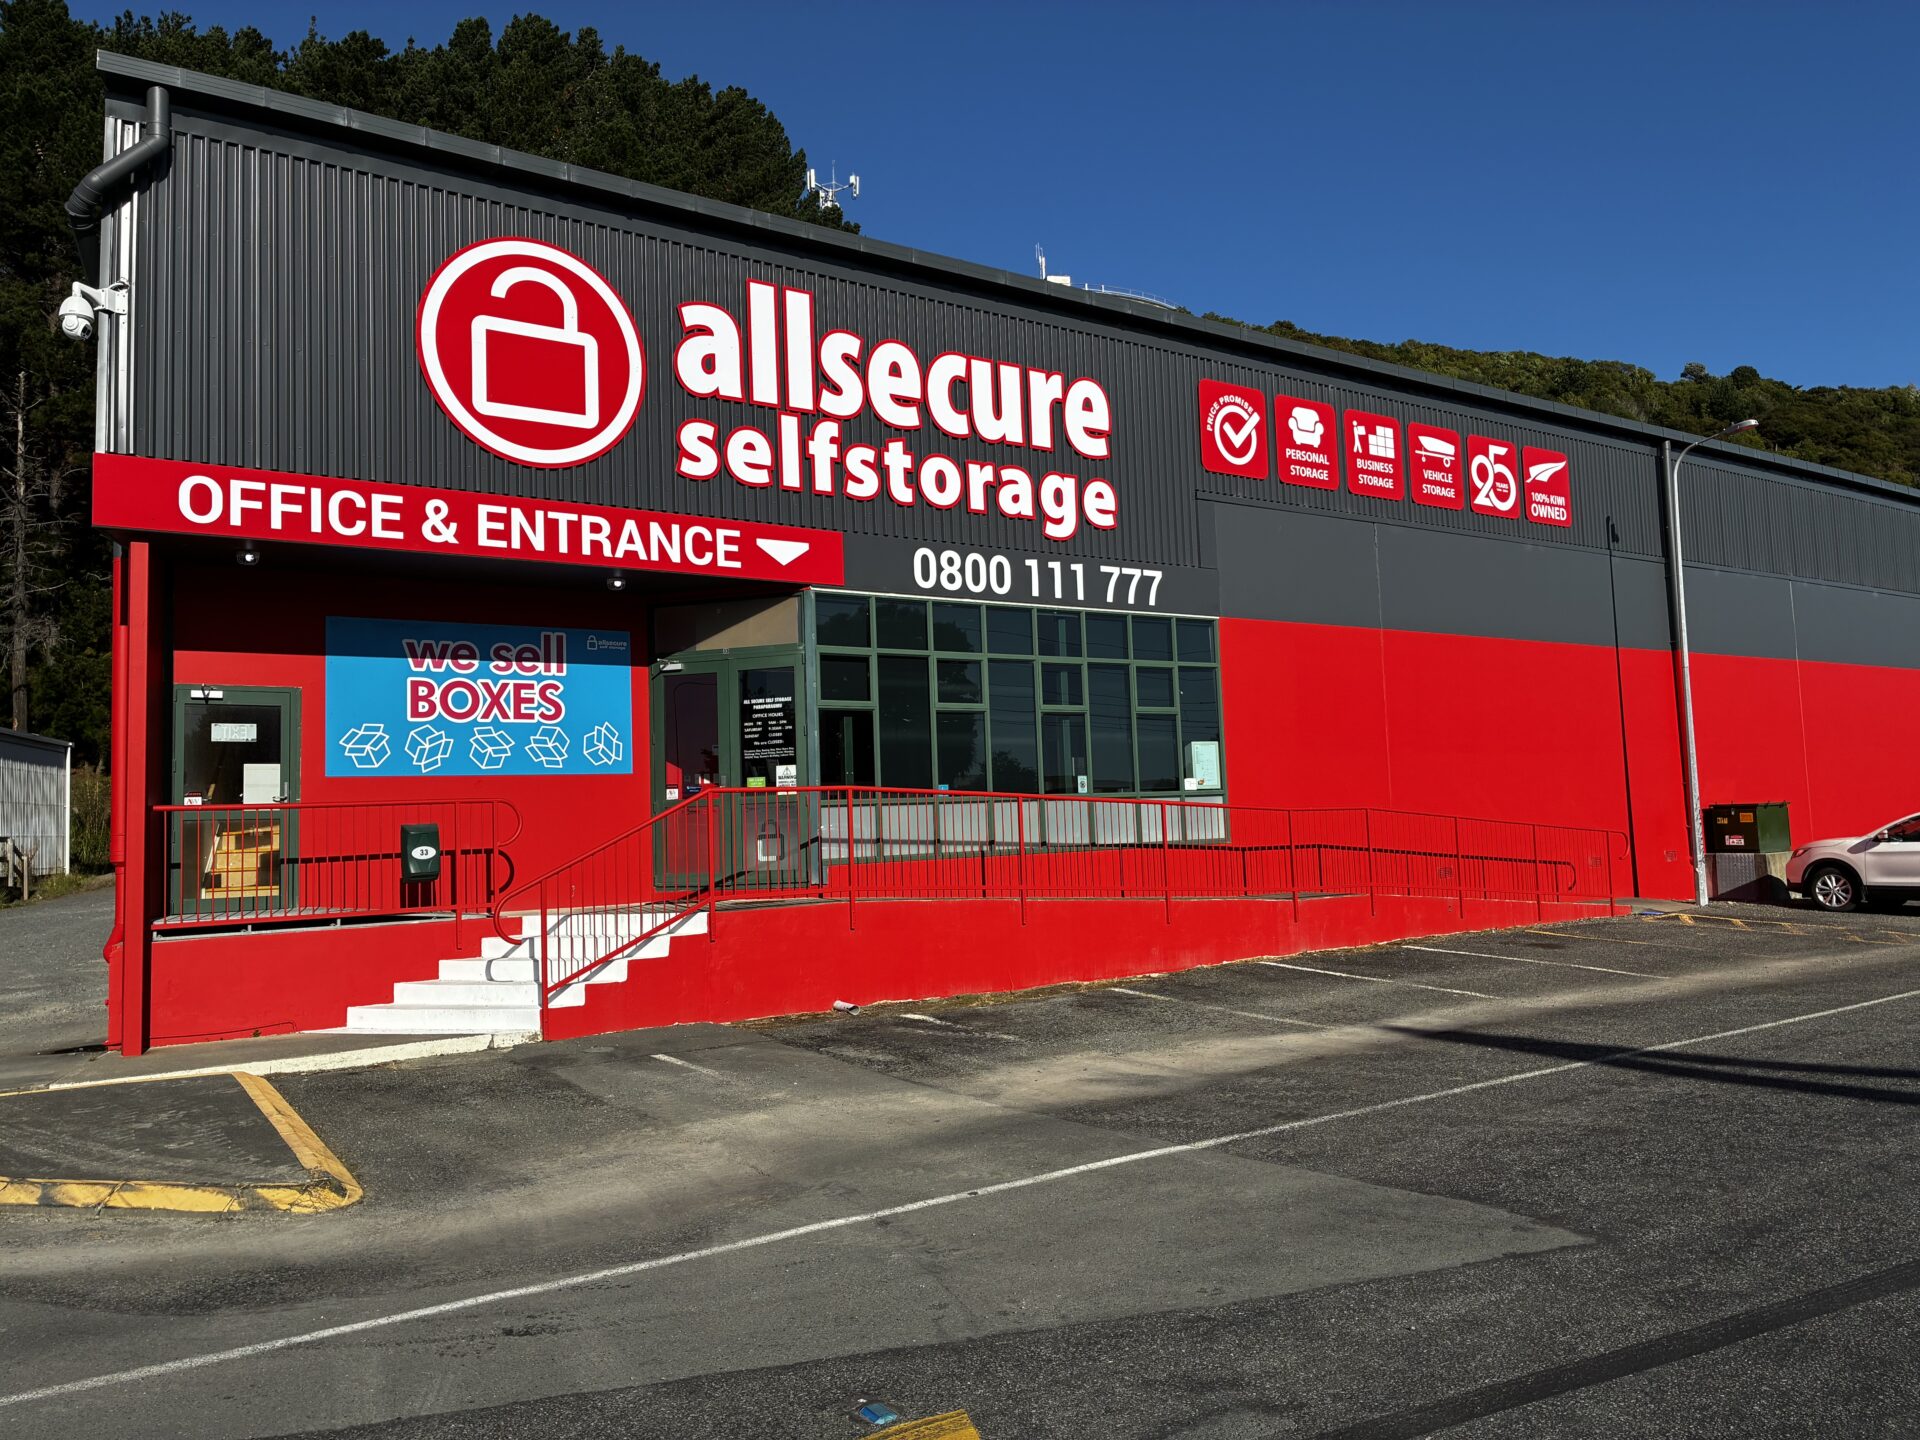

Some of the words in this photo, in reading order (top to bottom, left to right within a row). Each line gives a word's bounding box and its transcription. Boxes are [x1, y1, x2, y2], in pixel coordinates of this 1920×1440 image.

[674, 278, 1112, 459] allsecure
[1206, 402, 1220, 432] PRICE
[1219, 394, 1254, 415] PROMISE
[1285, 447, 1330, 465] PERSONAL
[1290, 465, 1329, 480] STORAGE
[1356, 458, 1394, 474] BUSINESS
[1358, 474, 1394, 489] STORAGE
[1422, 469, 1453, 483] VEHICLE
[1471, 444, 1516, 511] 25
[1422, 484, 1456, 498] STORAGE
[1531, 492, 1550, 504] 100%
[1549, 495, 1566, 506] KIWI
[1531, 503, 1567, 521] OWNED
[178, 475, 404, 540] OFFICE
[421, 499, 459, 544] &
[477, 504, 742, 568] ENTRANCE
[913, 547, 1011, 595] 0800
[1025, 558, 1084, 601] 111
[1100, 565, 1163, 606] 777
[402, 639, 479, 674] we
[489, 632, 567, 676] sell
[407, 677, 565, 723] BOXES
